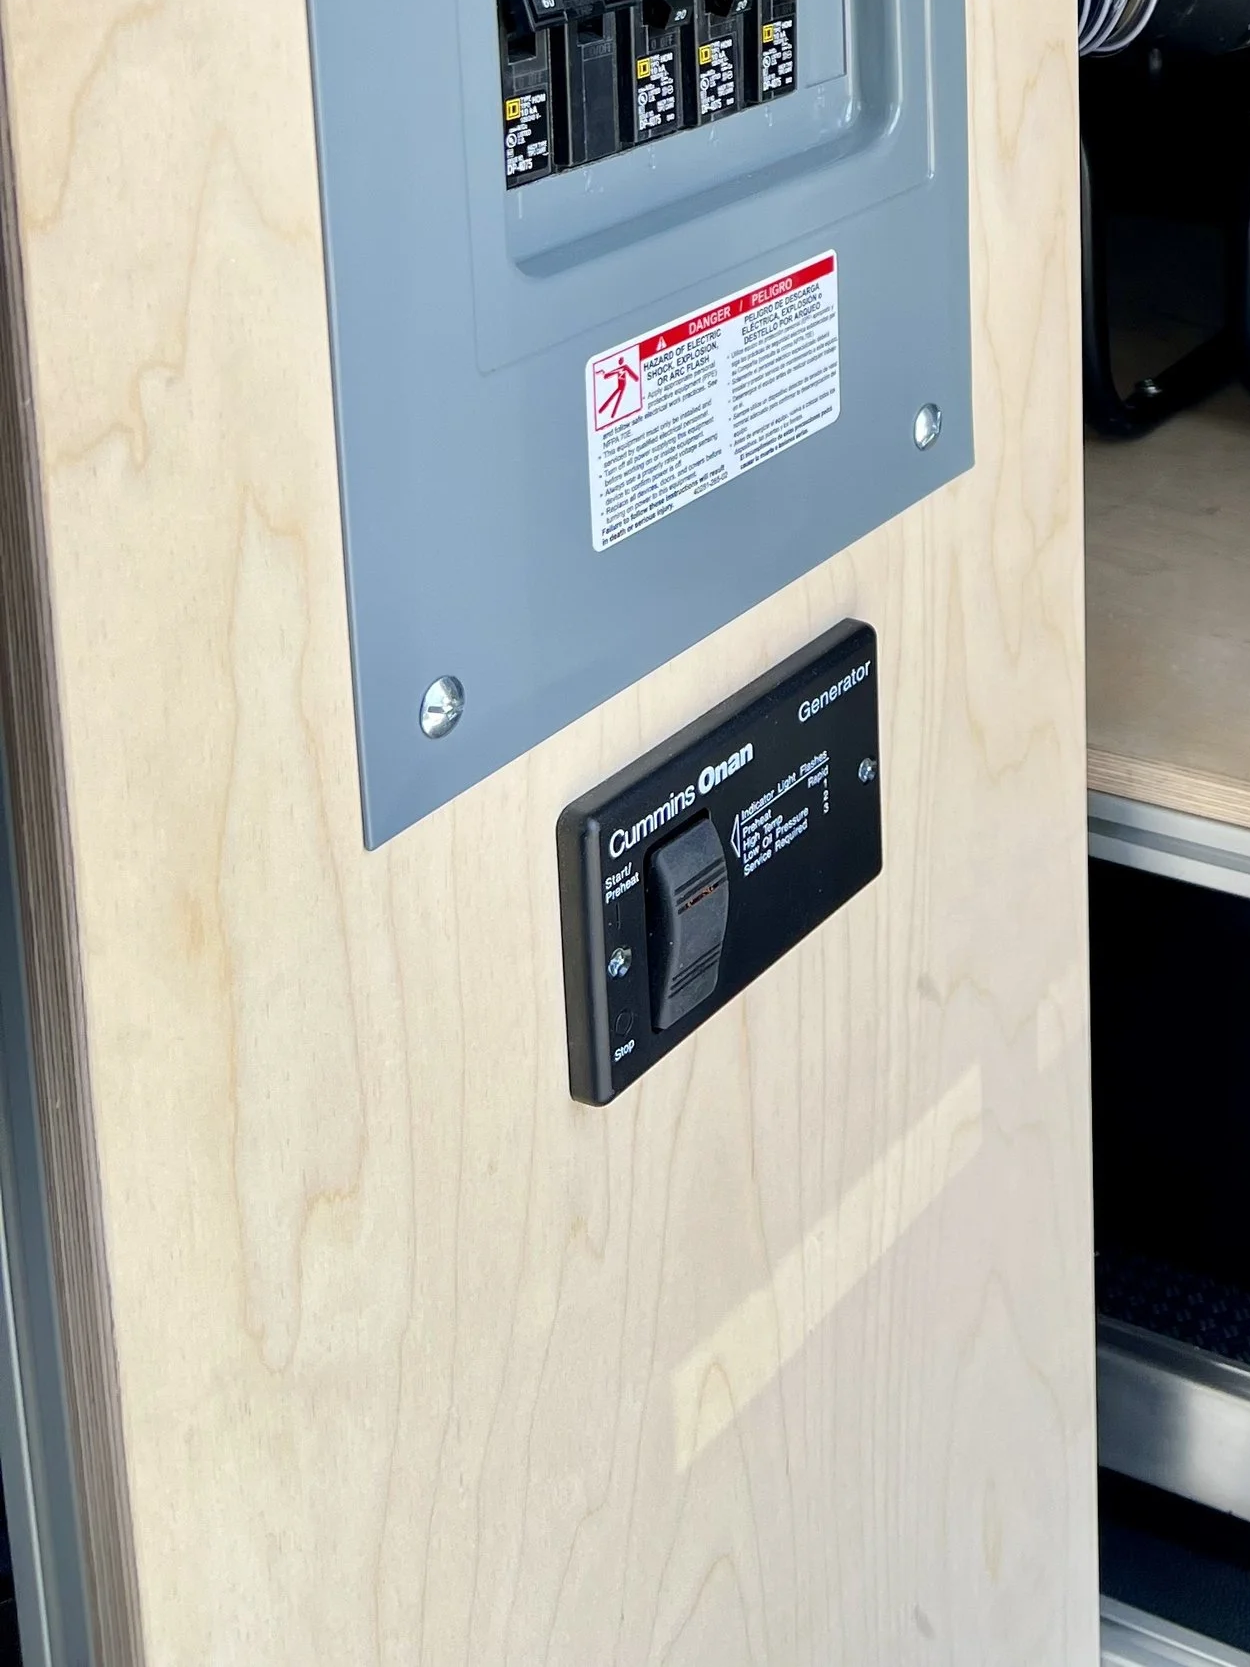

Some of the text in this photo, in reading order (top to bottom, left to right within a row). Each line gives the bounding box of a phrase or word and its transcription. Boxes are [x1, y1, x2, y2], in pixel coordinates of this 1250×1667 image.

[674, 9, 687, 21] 20
[736, 0, 748, 11] 20
[688, 278, 792, 335] DANGER PELIGRO
[744, 283, 820, 324] PELIGRO DE DESCARGA
[744, 302, 820, 344] DESTELLO POR ARQUEO
[644, 329, 721, 371] HAZARD OF ELECTRIC
[657, 355, 709, 386] OR ARC FLASH
[798, 660, 871, 723] Generator
[610, 743, 754, 859] Cummins Onan
[741, 750, 828, 820] Indicator Light Flashes
[742, 765, 829, 838] Preheat Rapid
[742, 832, 760, 850] High
[763, 815, 783, 835] Temp
[743, 790, 829, 864] Low Oil Pressure 2
[743, 802, 829, 877] Service Required 3
[605, 862, 632, 890] Start/
[605, 872, 639, 904] Preheat
[615, 1039, 634, 1062] Stop
